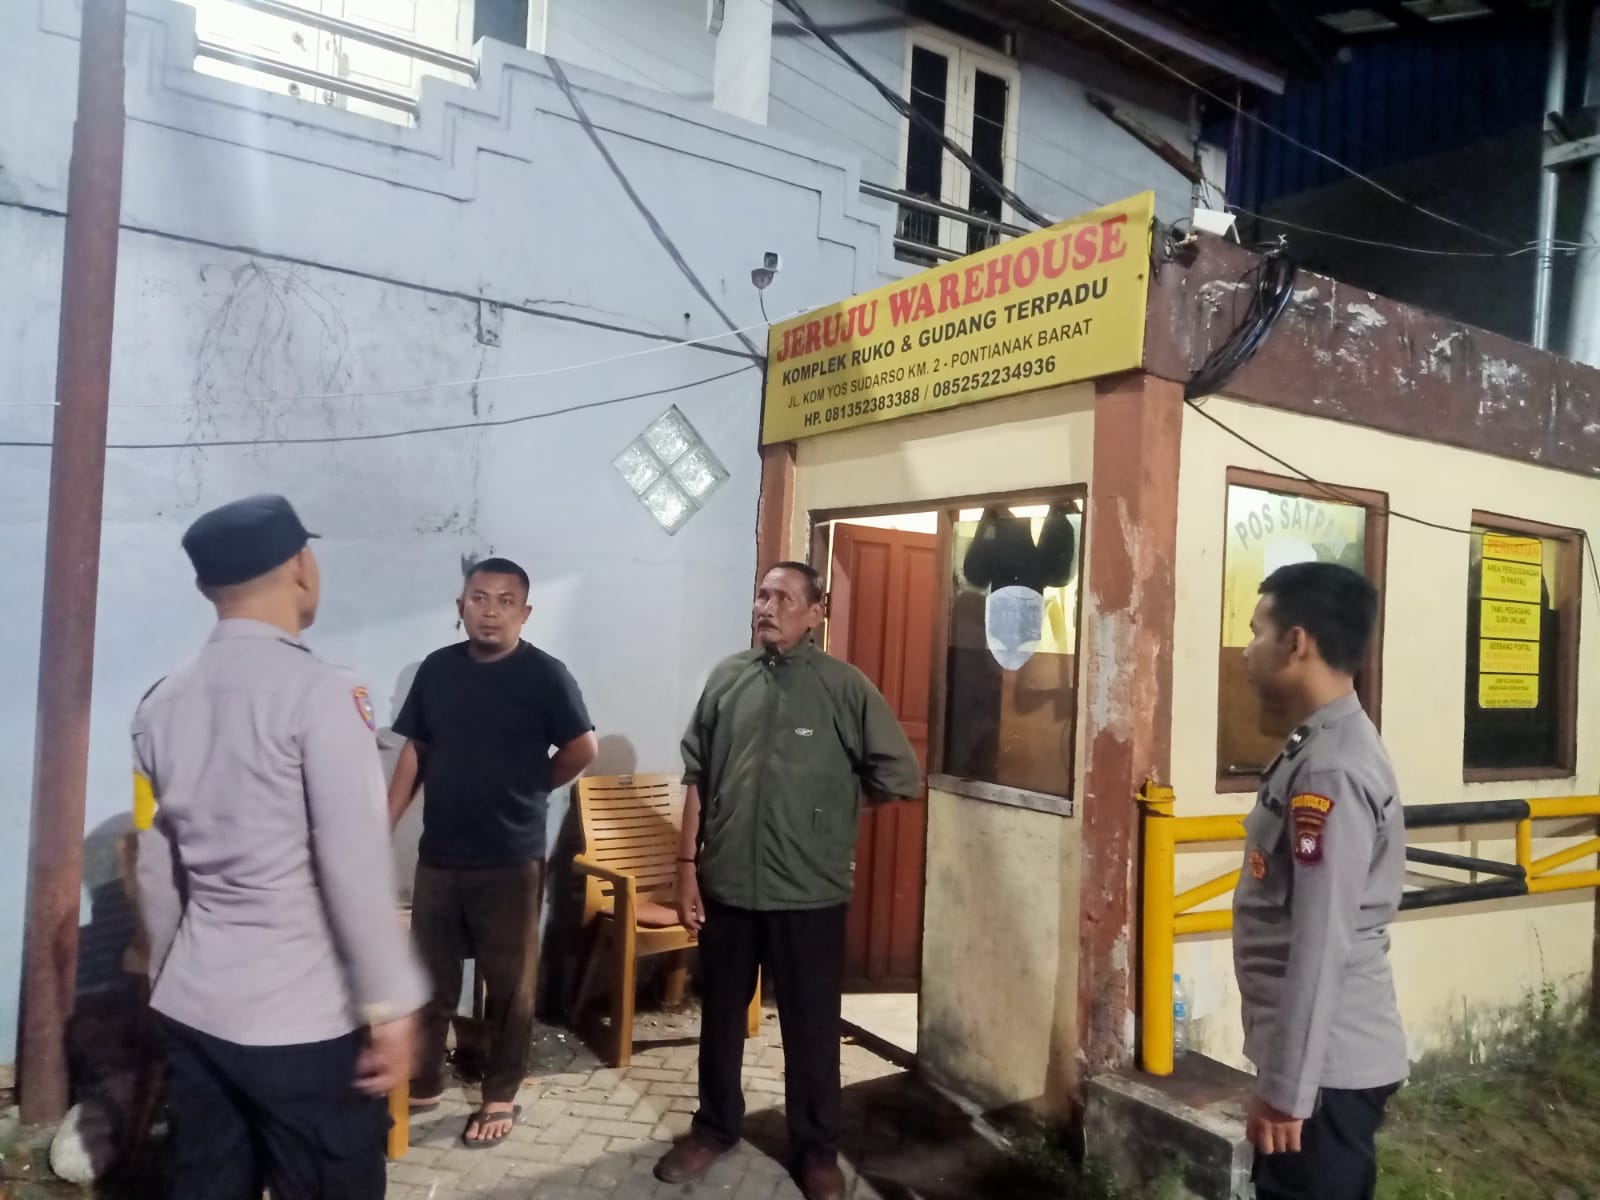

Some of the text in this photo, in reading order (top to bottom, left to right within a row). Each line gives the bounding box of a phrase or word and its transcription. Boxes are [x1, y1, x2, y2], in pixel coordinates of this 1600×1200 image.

[777, 214, 1127, 362] JERUJU WAREHOUSE
[782, 277, 1108, 386] KOMPLEK RUKO & GUDANG TERPADU
[803, 389, 825, 405] KOM
[827, 382, 848, 398] YOS
[850, 367, 905, 393] SUDARSO
[908, 362, 930, 380] KM.
[933, 358, 940, 373] 2
[951, 334, 1033, 368] PONTIANAK
[1038, 318, 1093, 346] BARAT
[804, 356, 1056, 427] HP. 081352383388 / 085252234936
[1235, 504, 1273, 552] POS
[1488, 539, 1539, 559] PERHATIAN
